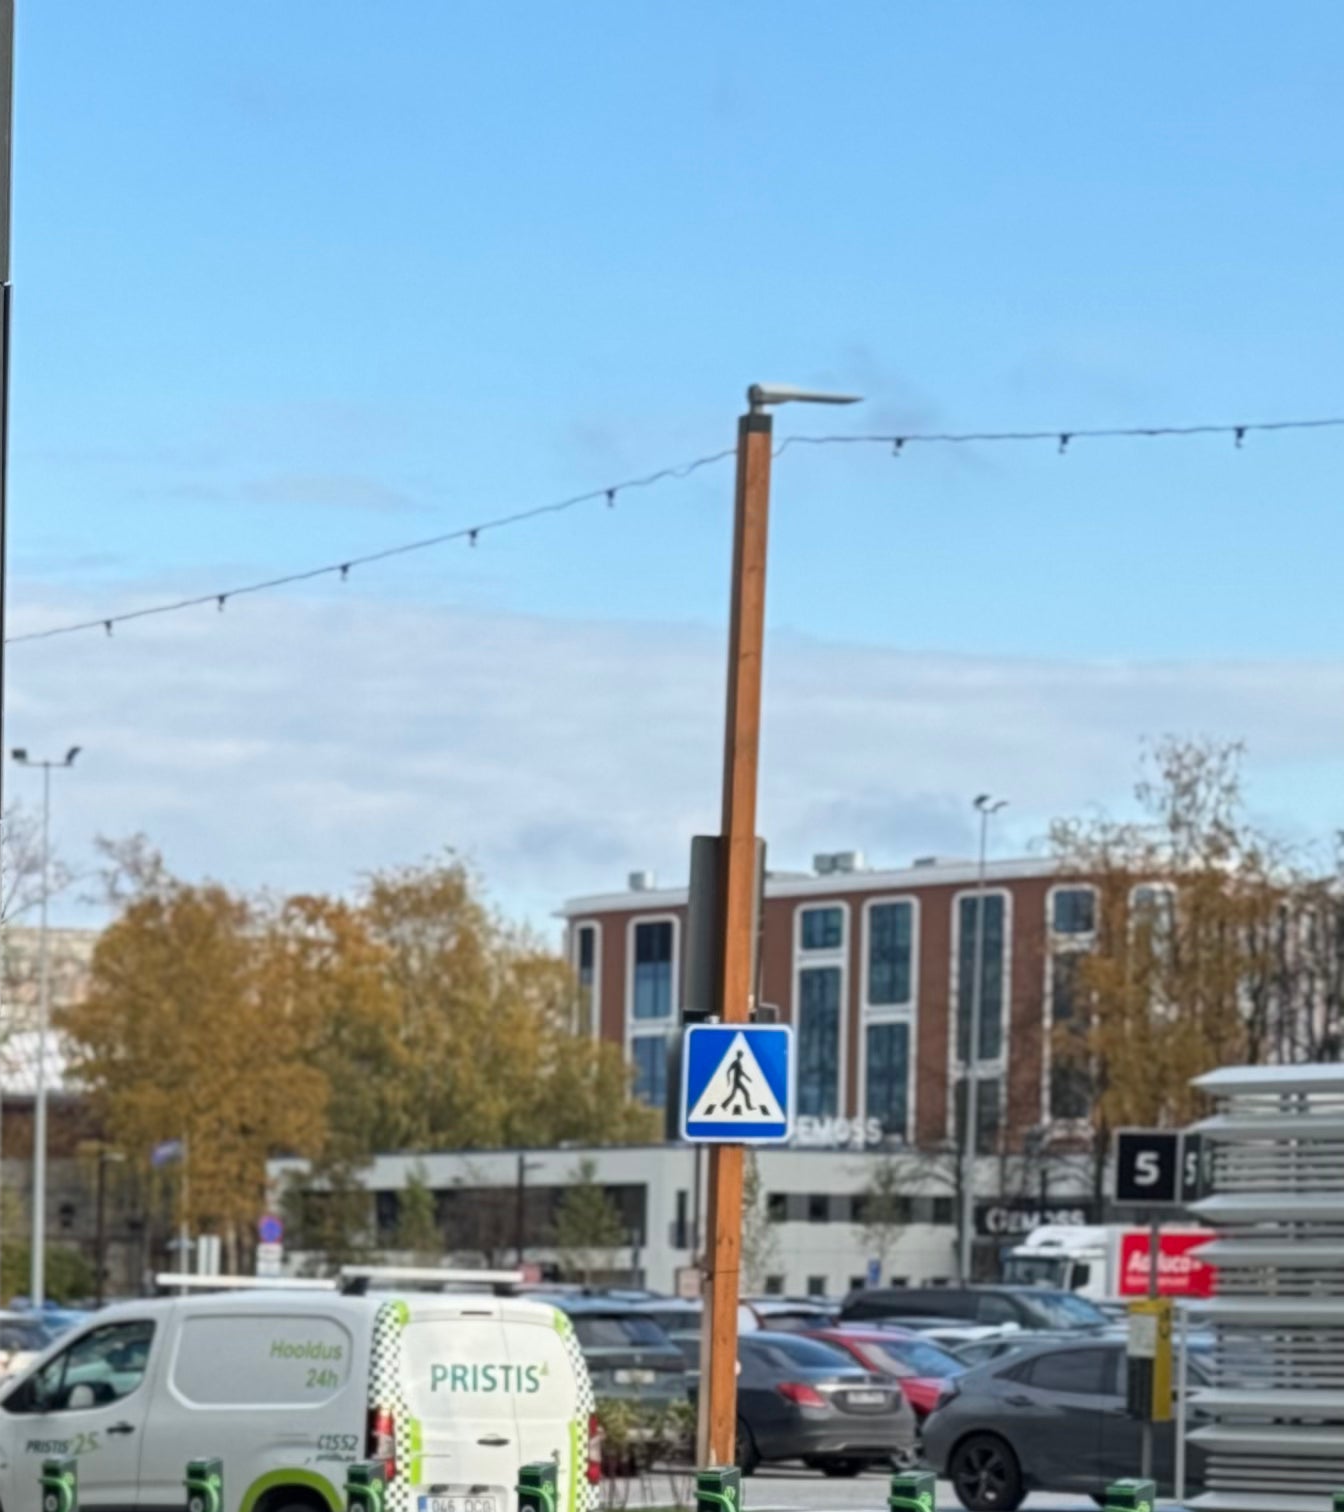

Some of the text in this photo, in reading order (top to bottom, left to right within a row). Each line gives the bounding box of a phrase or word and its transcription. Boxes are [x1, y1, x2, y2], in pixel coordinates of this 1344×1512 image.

[1133, 1151, 1160, 1186] 5
[270, 1338, 343, 1360] Hooldus
[305, 1368, 339, 1388] 24h
[431, 1363, 541, 1393] PRISTIS
